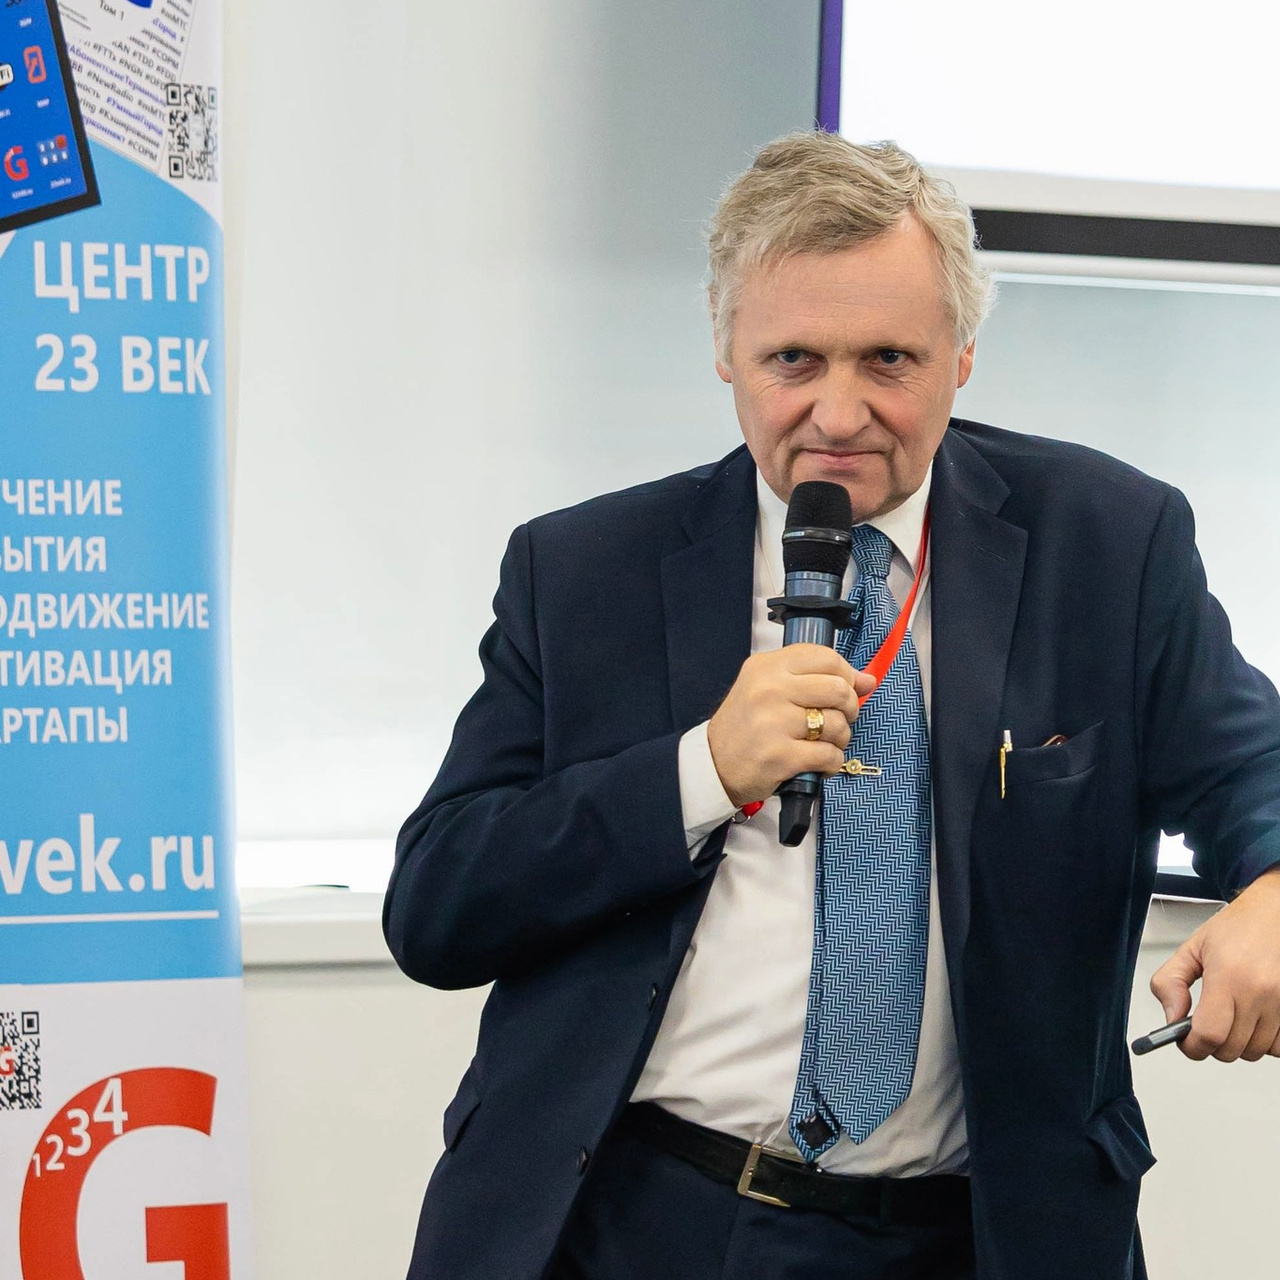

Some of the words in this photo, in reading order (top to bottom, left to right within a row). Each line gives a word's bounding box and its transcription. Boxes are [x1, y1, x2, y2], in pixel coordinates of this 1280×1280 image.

[33, 240, 211, 314] ЦЕНТР
[34, 333, 99, 393] 23
[121, 335, 212, 396] ВЕК
[0, 478, 123, 516] ЧЕНИЕ
[0, 536, 107, 573] ЫТИЯ
[0, 593, 209, 638] ДВИЖЕНИЕ
[0, 706, 128, 744] РТАПЫ
[0, 813, 216, 895] vek.ru
